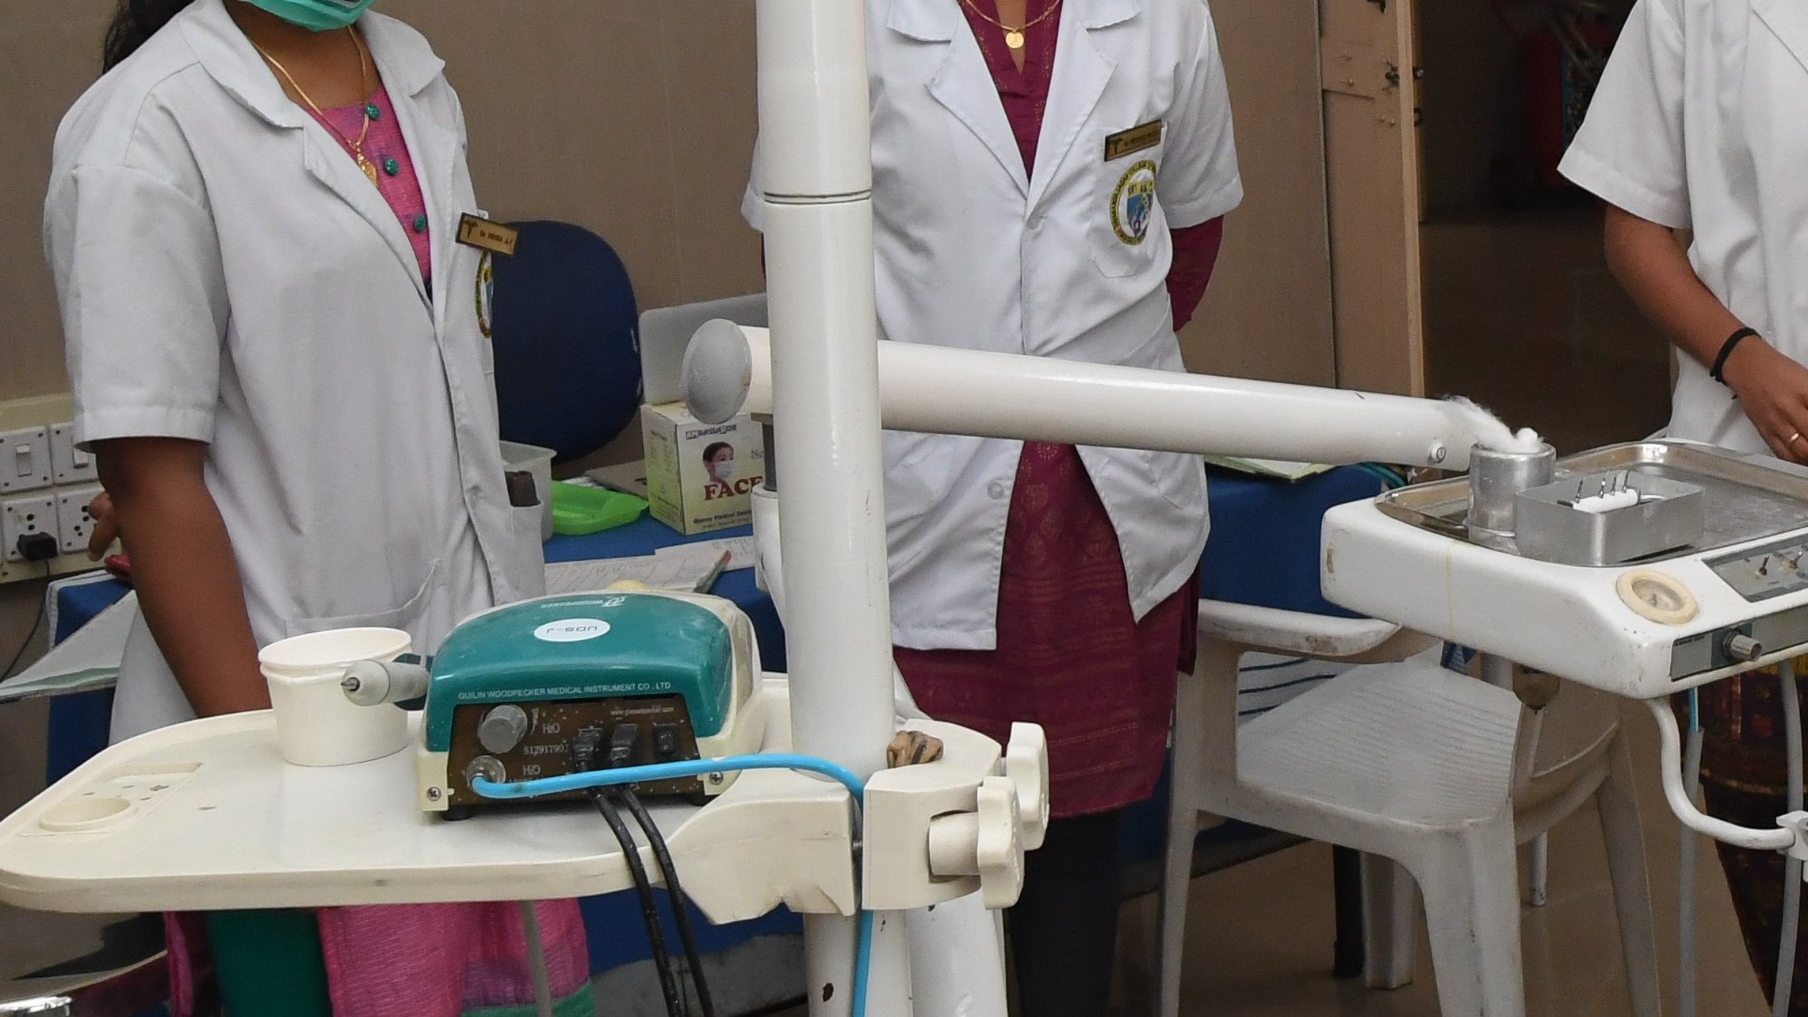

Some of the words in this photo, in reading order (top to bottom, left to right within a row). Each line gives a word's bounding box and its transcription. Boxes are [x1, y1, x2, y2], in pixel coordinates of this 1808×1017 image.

[458, 692, 486, 700] GUILIN
[547, 686, 583, 695] MEDICAL
[584, 684, 636, 693] INSTRUMENT
